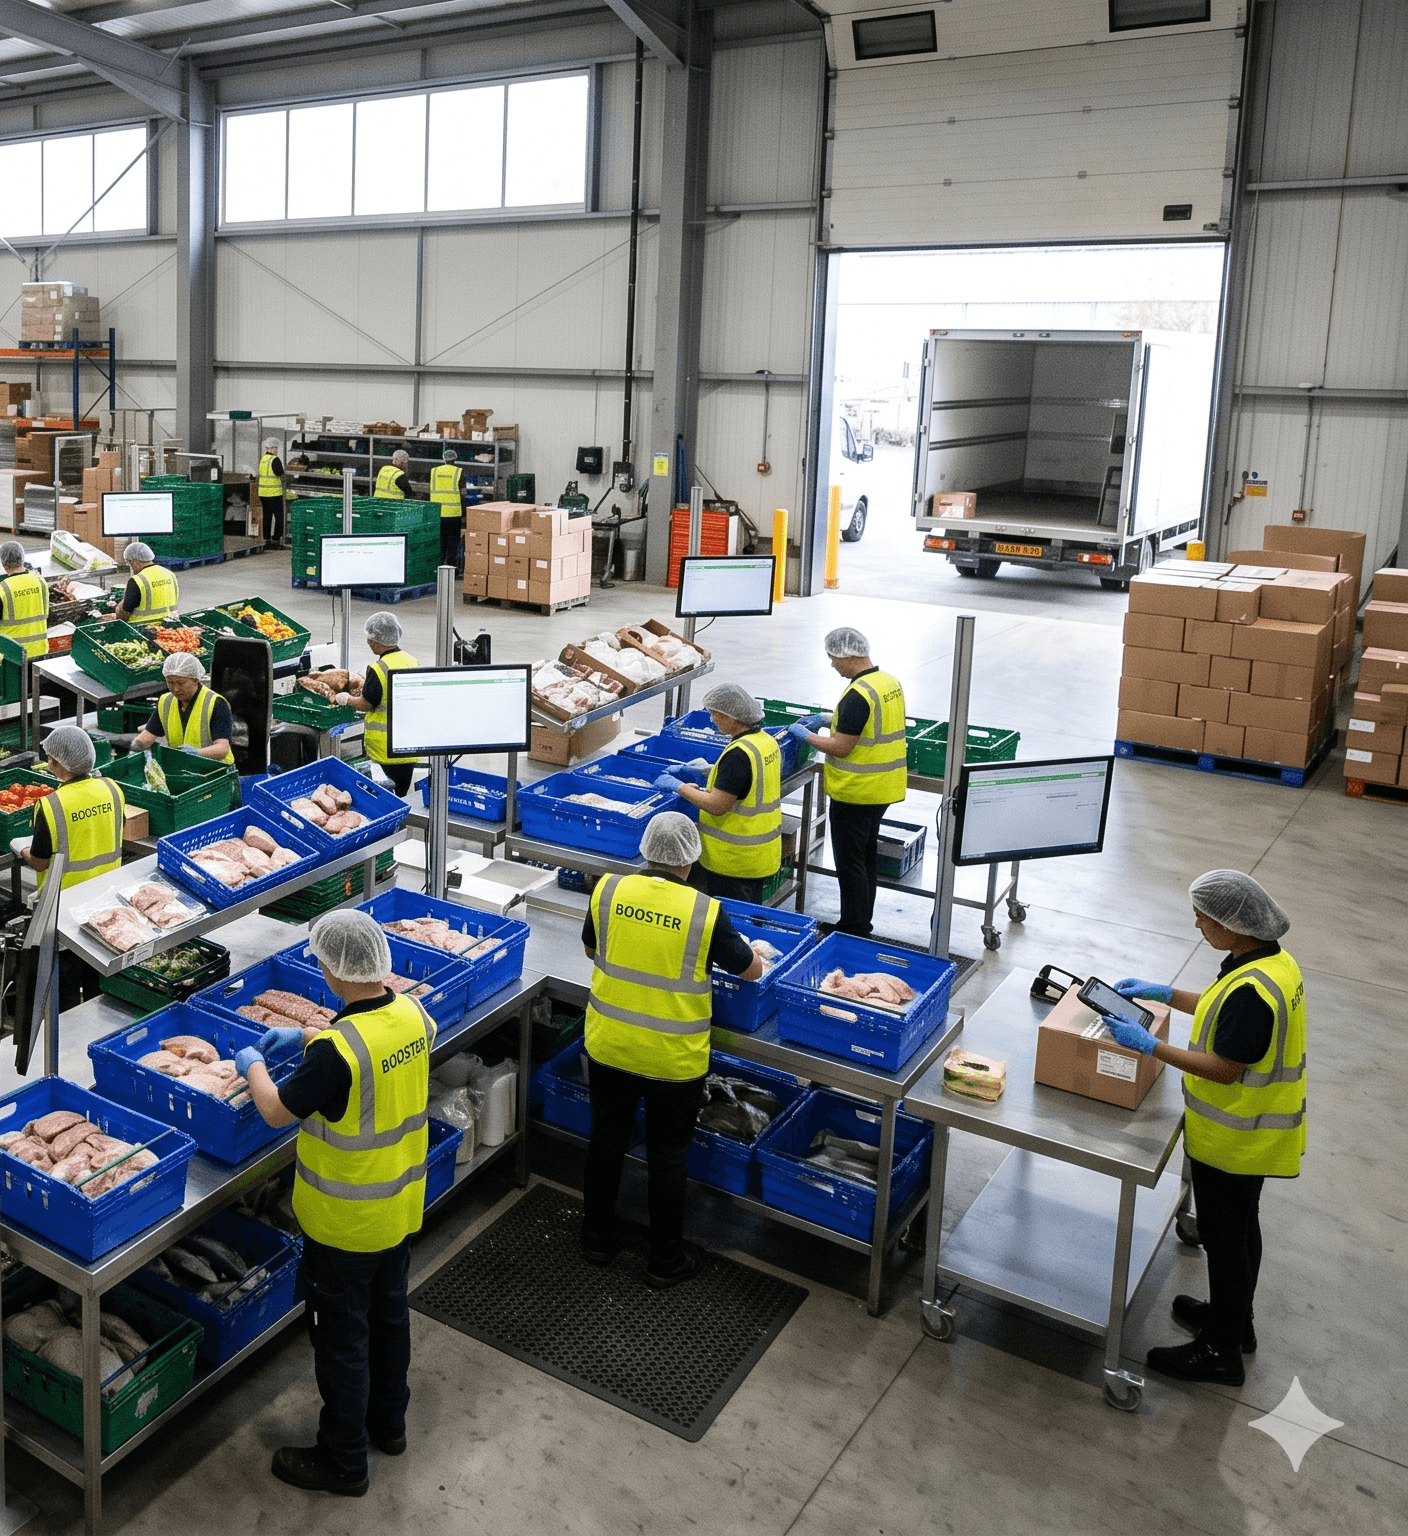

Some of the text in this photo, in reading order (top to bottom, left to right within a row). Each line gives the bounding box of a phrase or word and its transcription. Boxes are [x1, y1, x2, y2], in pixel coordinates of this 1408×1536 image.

[71, 802, 112, 823] BOOSTER
[615, 903, 682, 931] BOOSTER
[381, 1036, 426, 1074] BOOSTER
